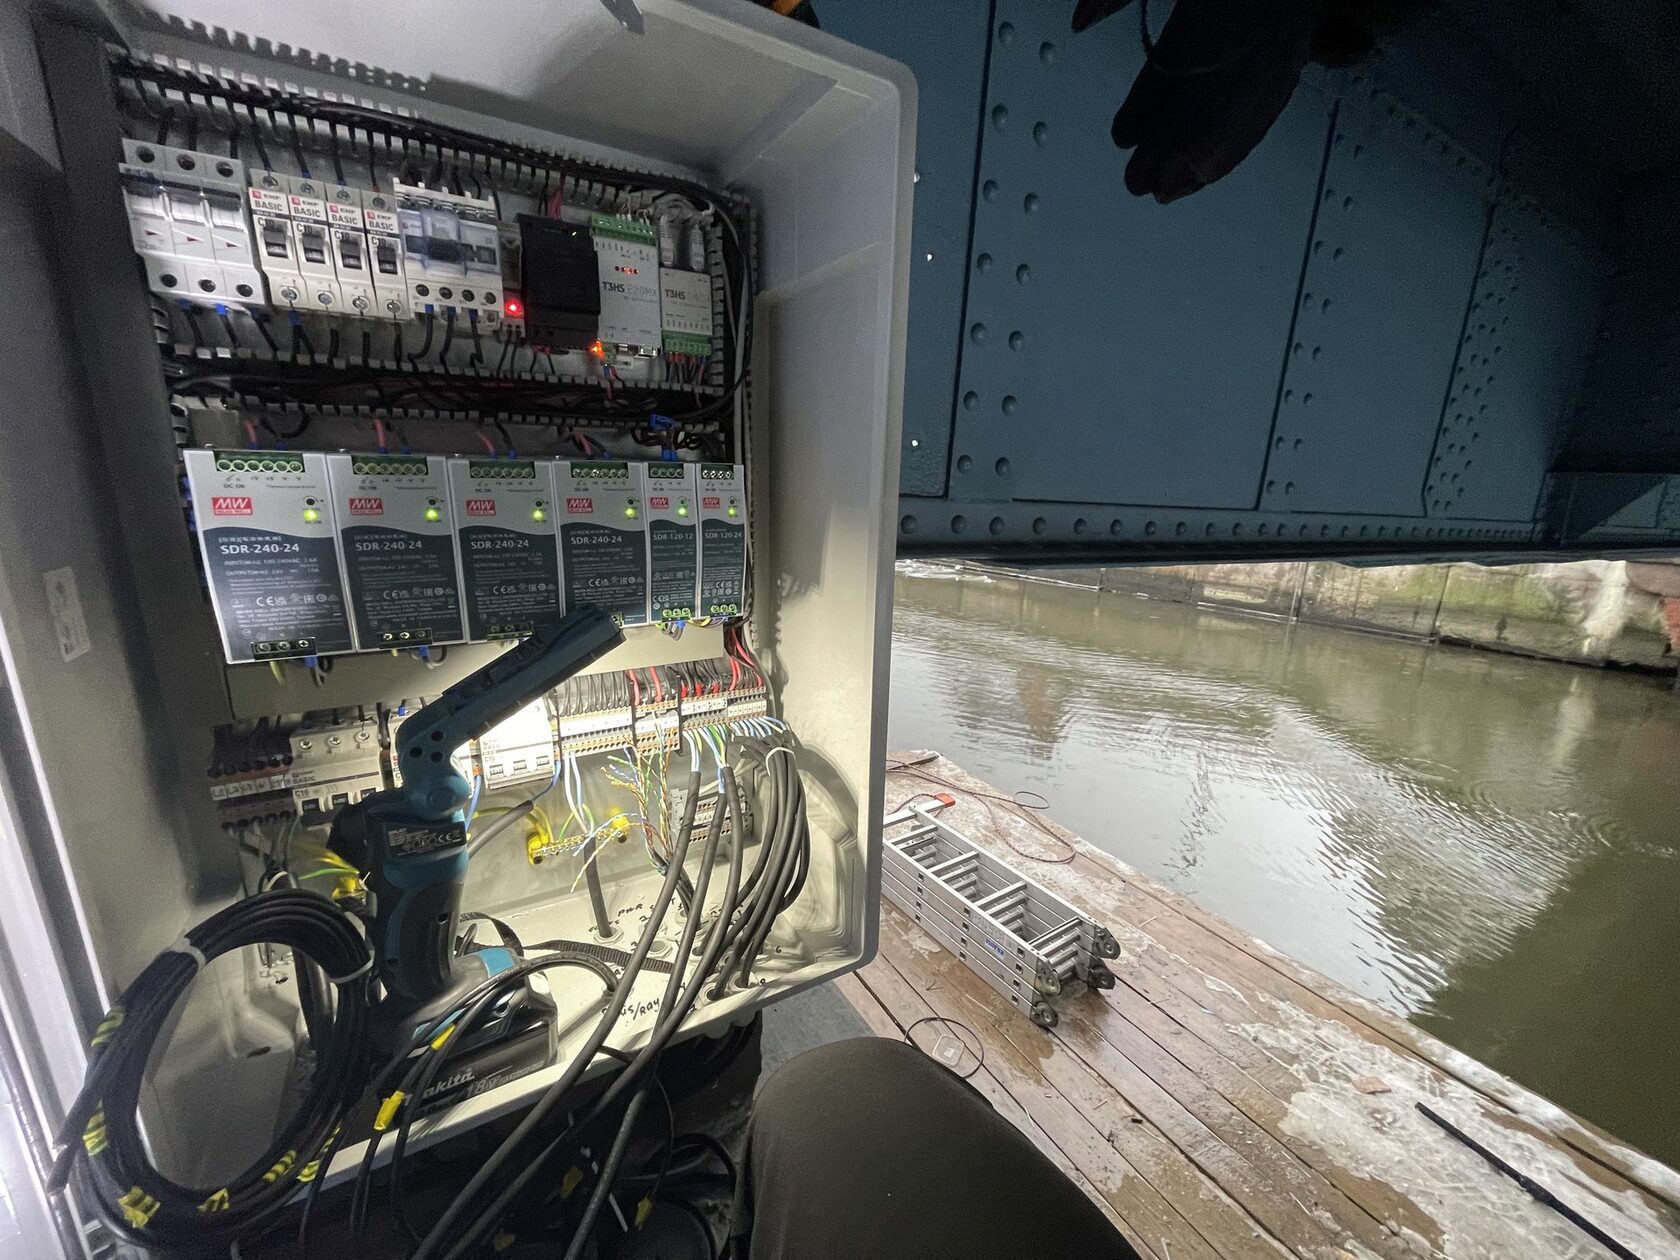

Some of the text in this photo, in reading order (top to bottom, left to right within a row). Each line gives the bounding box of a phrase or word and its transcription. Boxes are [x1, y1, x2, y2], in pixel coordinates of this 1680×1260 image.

[254, 200, 284, 212] BASIC
[293, 206, 321, 218] BASIC
[257, 217, 274, 228] C10
[331, 213, 358, 226] BASIC
[296, 223, 313, 234] C10
[368, 220, 394, 231] BASIC
[334, 230, 350, 240] C10
[371, 236, 387, 247] C10
[602, 281, 625, 293] T3HS
[665, 288, 686, 300] T3HS
[214, 498, 249, 509] MW
[352, 499, 380, 509] MW
[468, 501, 493, 510] MW
[568, 499, 591, 508] MW
[355, 540, 422, 551] SDR-240-24
[471, 539, 530, 550] SDR-240-24
[571, 535, 622, 545] SDR-240-24
[219, 543, 300, 555] SDR-240-24
[618, 903, 643, 916] PWR
